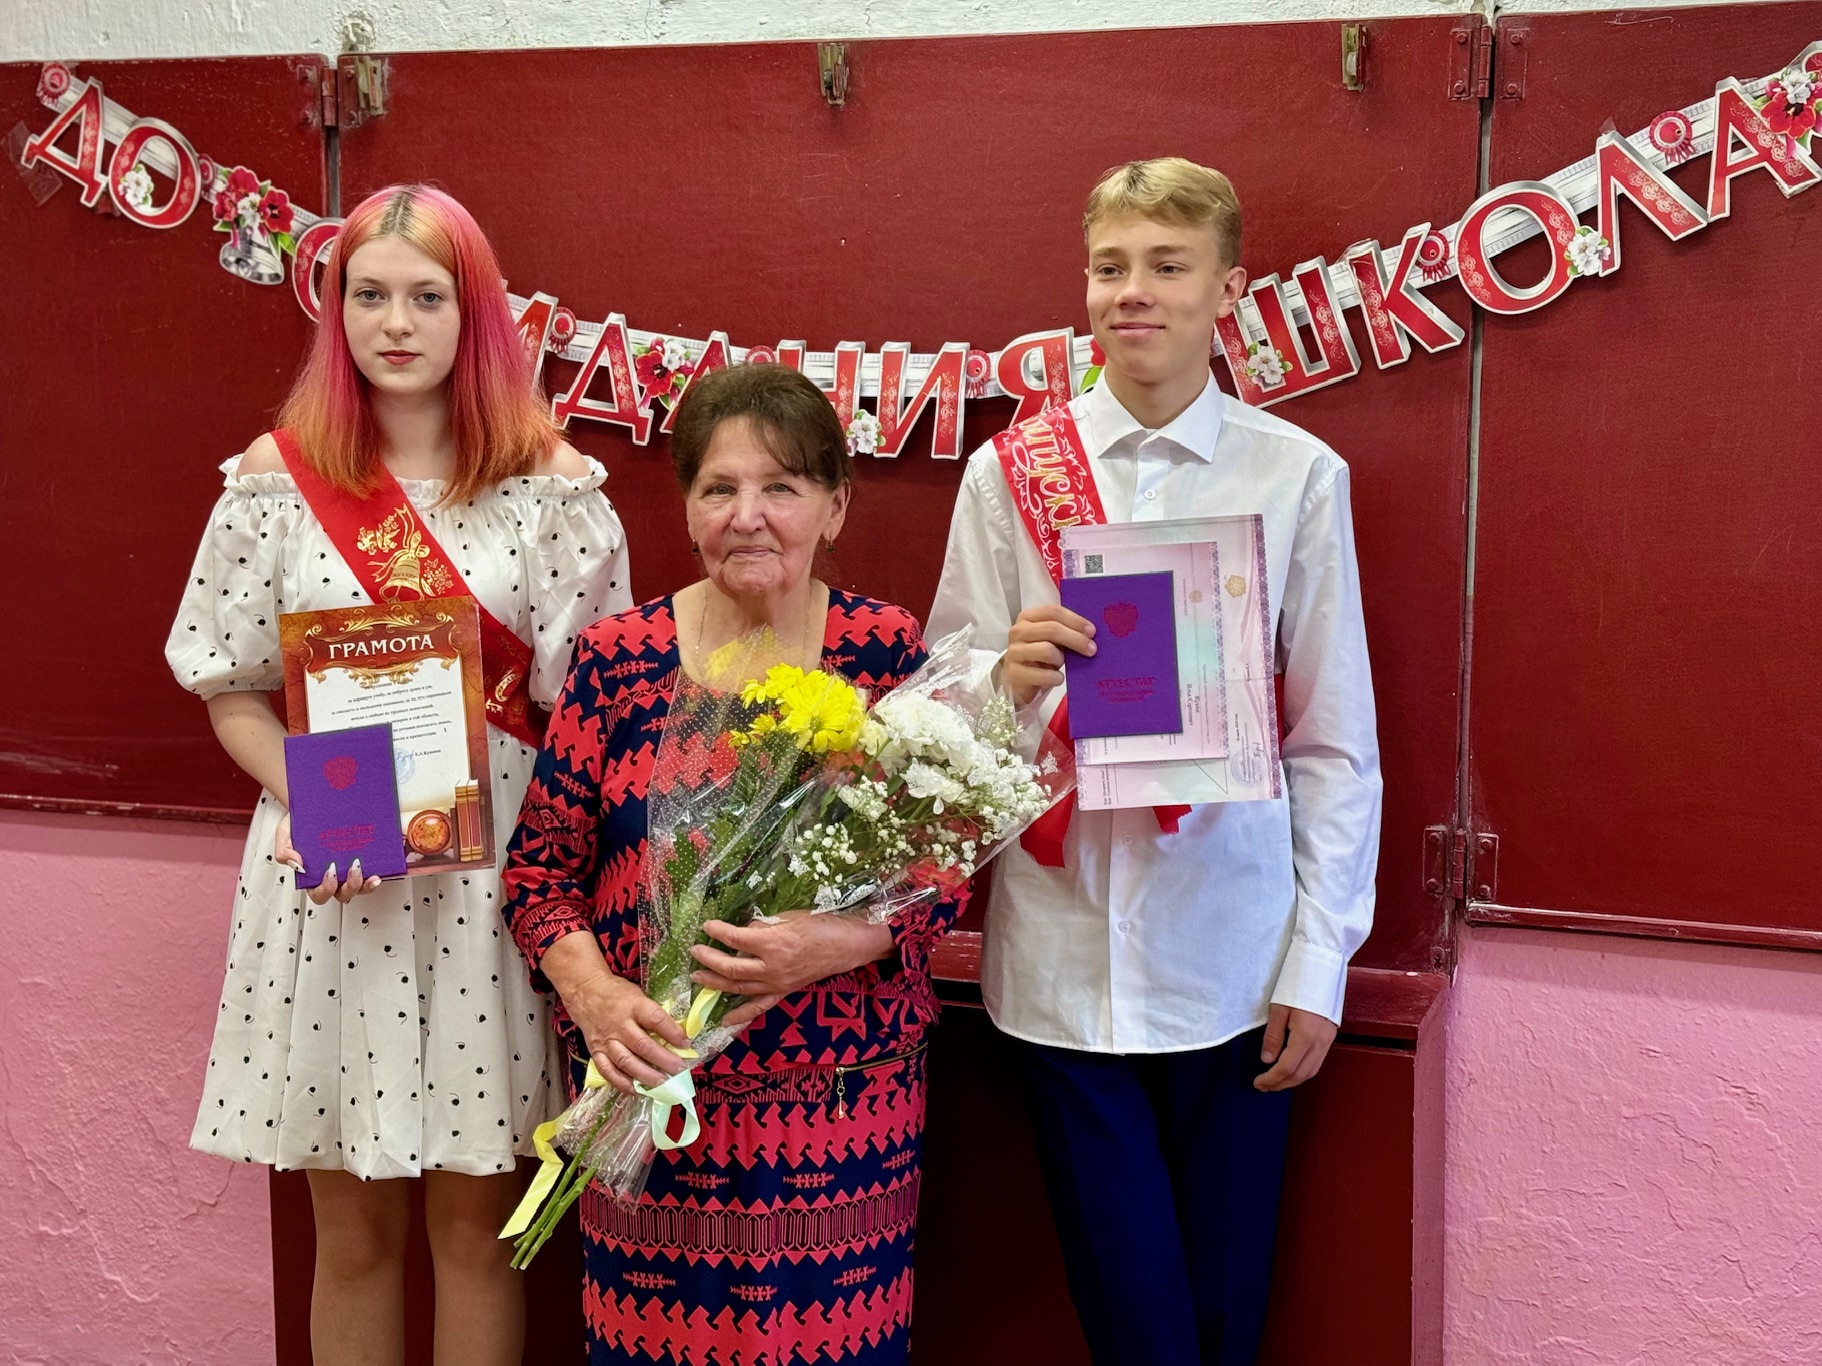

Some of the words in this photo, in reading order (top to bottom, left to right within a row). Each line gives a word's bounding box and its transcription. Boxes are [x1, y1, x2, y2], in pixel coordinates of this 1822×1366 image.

[20, 76, 202, 230] ДО
[1213, 76, 1822, 410] ШКОЛА
[328, 633, 435, 660] ГРАМОТА
